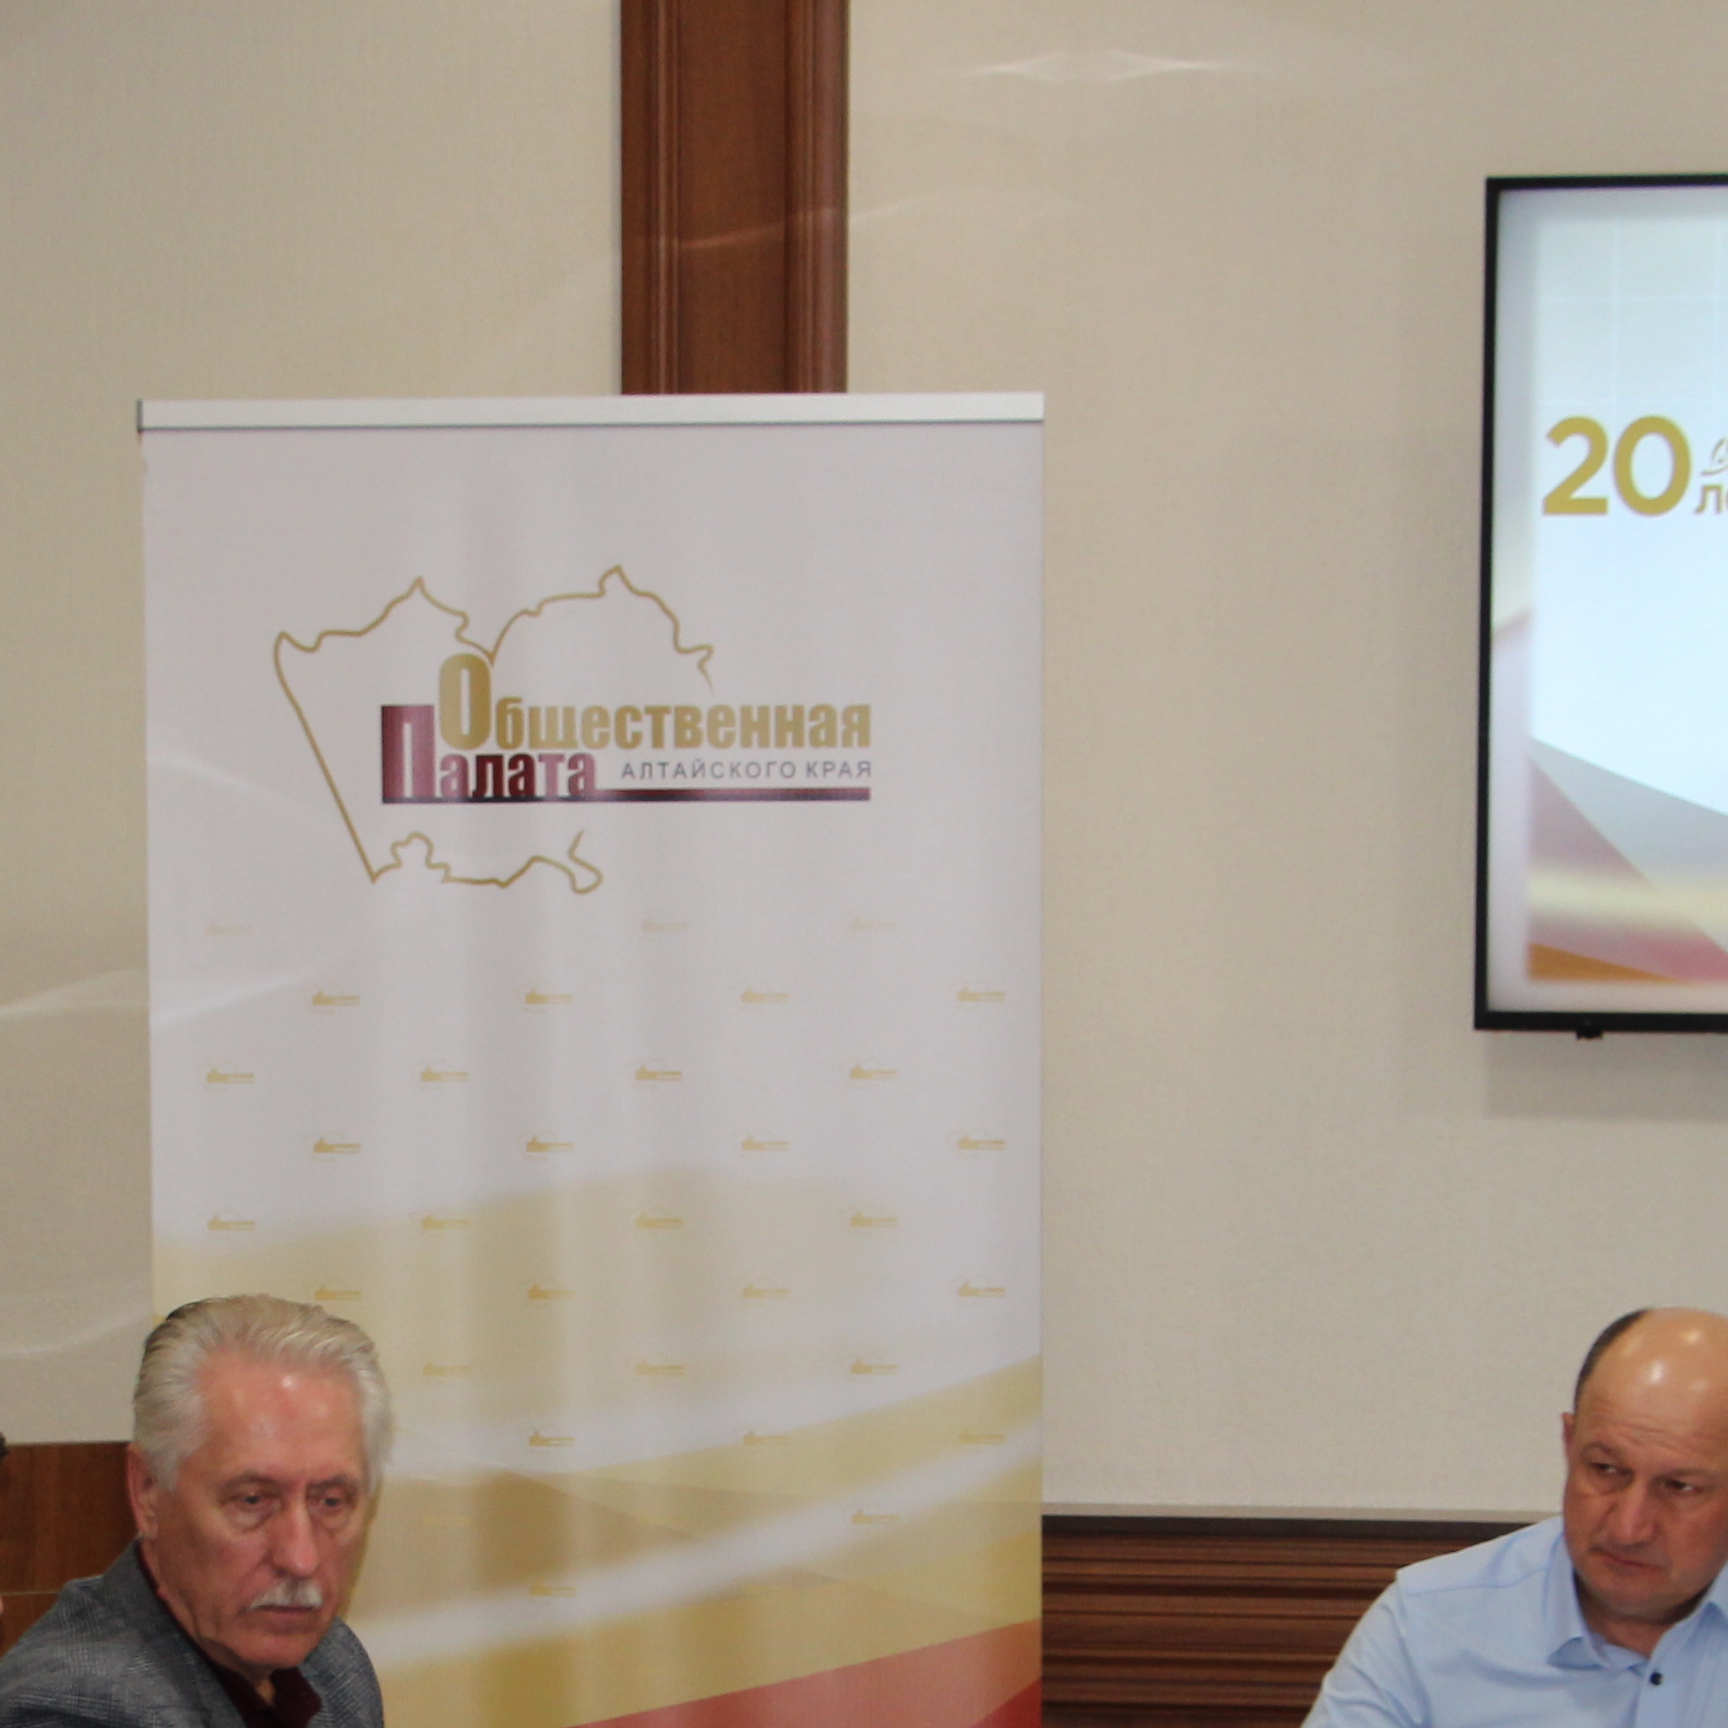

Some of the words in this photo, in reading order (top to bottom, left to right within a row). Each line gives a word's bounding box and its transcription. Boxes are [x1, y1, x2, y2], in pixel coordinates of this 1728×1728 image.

[1543, 415, 1691, 516] 20
[439, 652, 871, 750] Общественная
[381, 705, 597, 800] Палата
[621, 757, 796, 780] АЛТАЙСКОГО
[806, 760, 871, 779] КРАЯ
